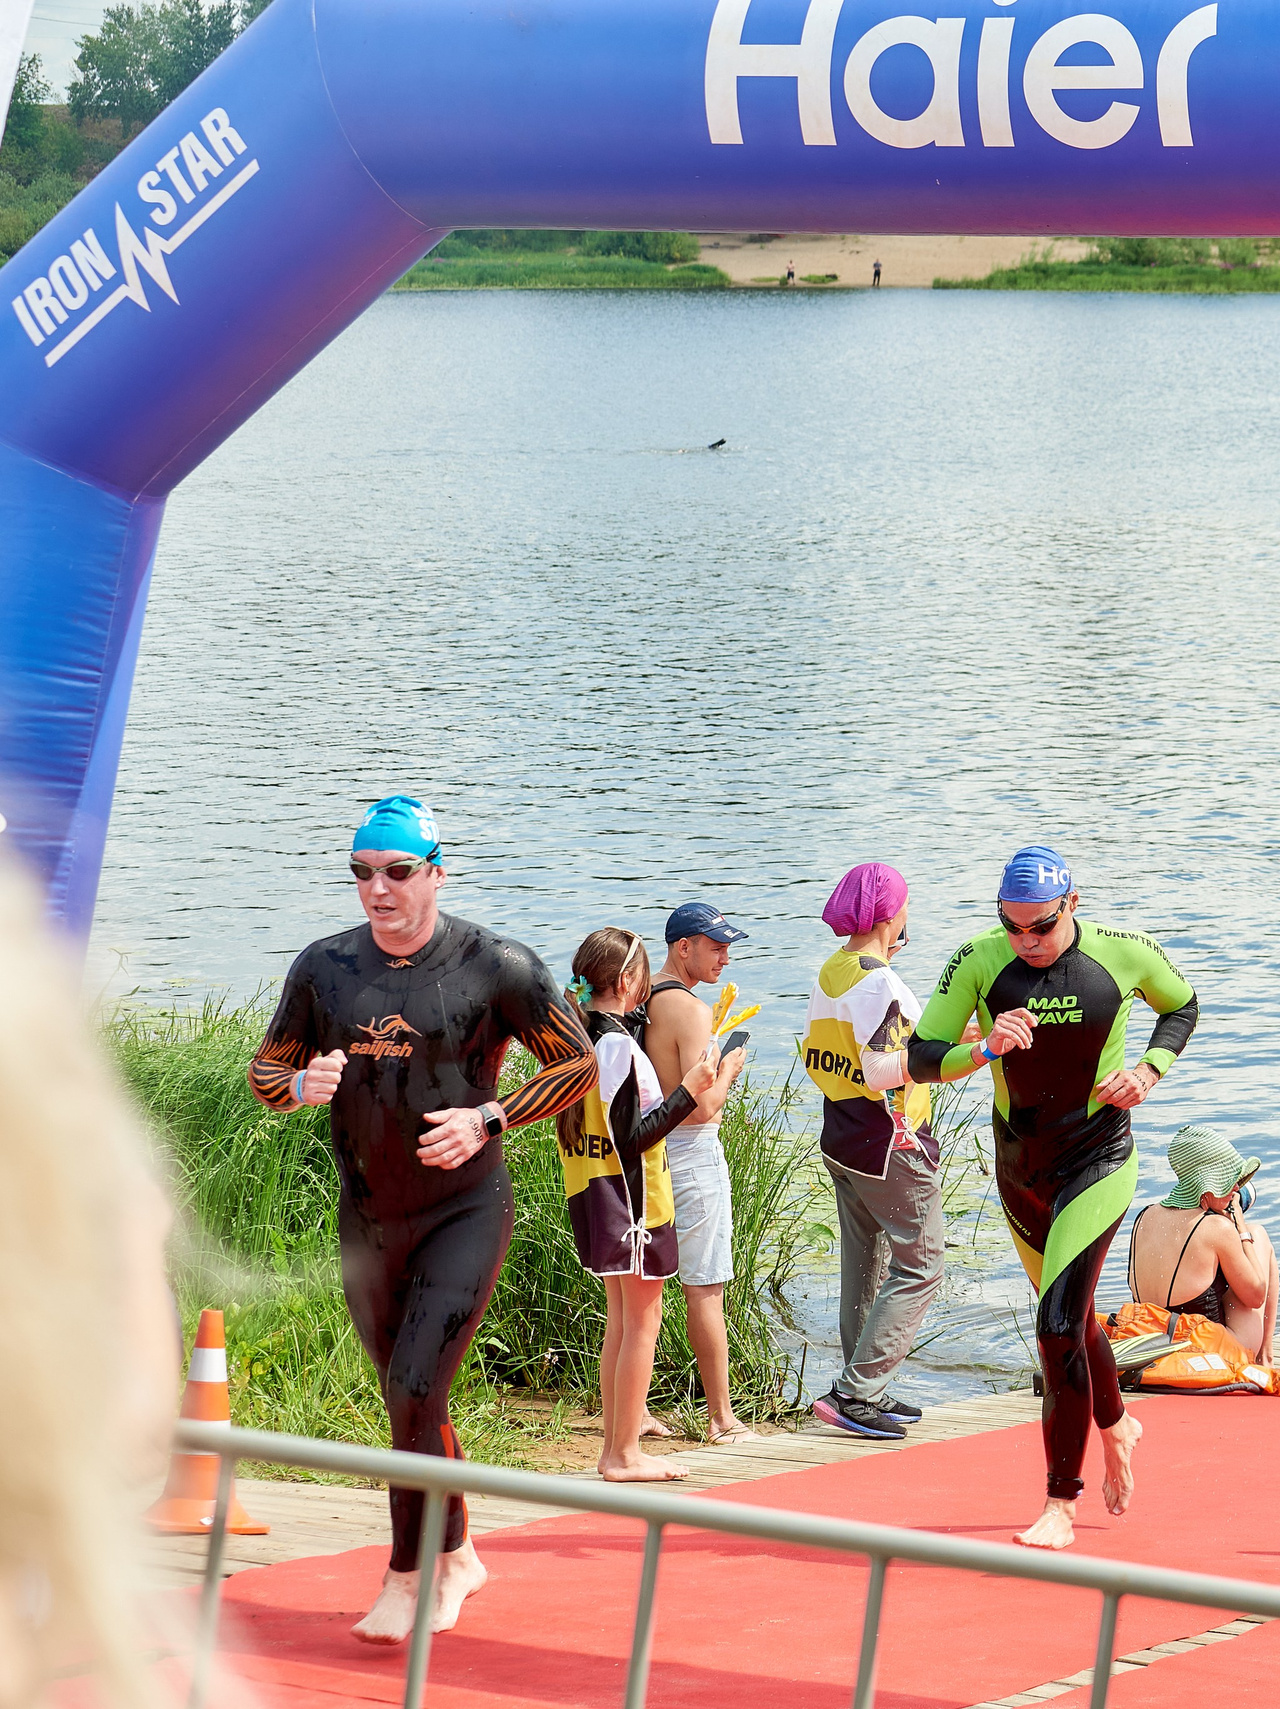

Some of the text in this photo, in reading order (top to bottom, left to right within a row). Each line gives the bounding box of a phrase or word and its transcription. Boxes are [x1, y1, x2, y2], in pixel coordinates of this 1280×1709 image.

[705, 0, 1217, 149] Haier
[11, 107, 248, 346] IRON STAR
[939, 942, 974, 995] WAVE
[1027, 995, 1078, 1010] MAD
[349, 1040, 414, 1061] sailfish
